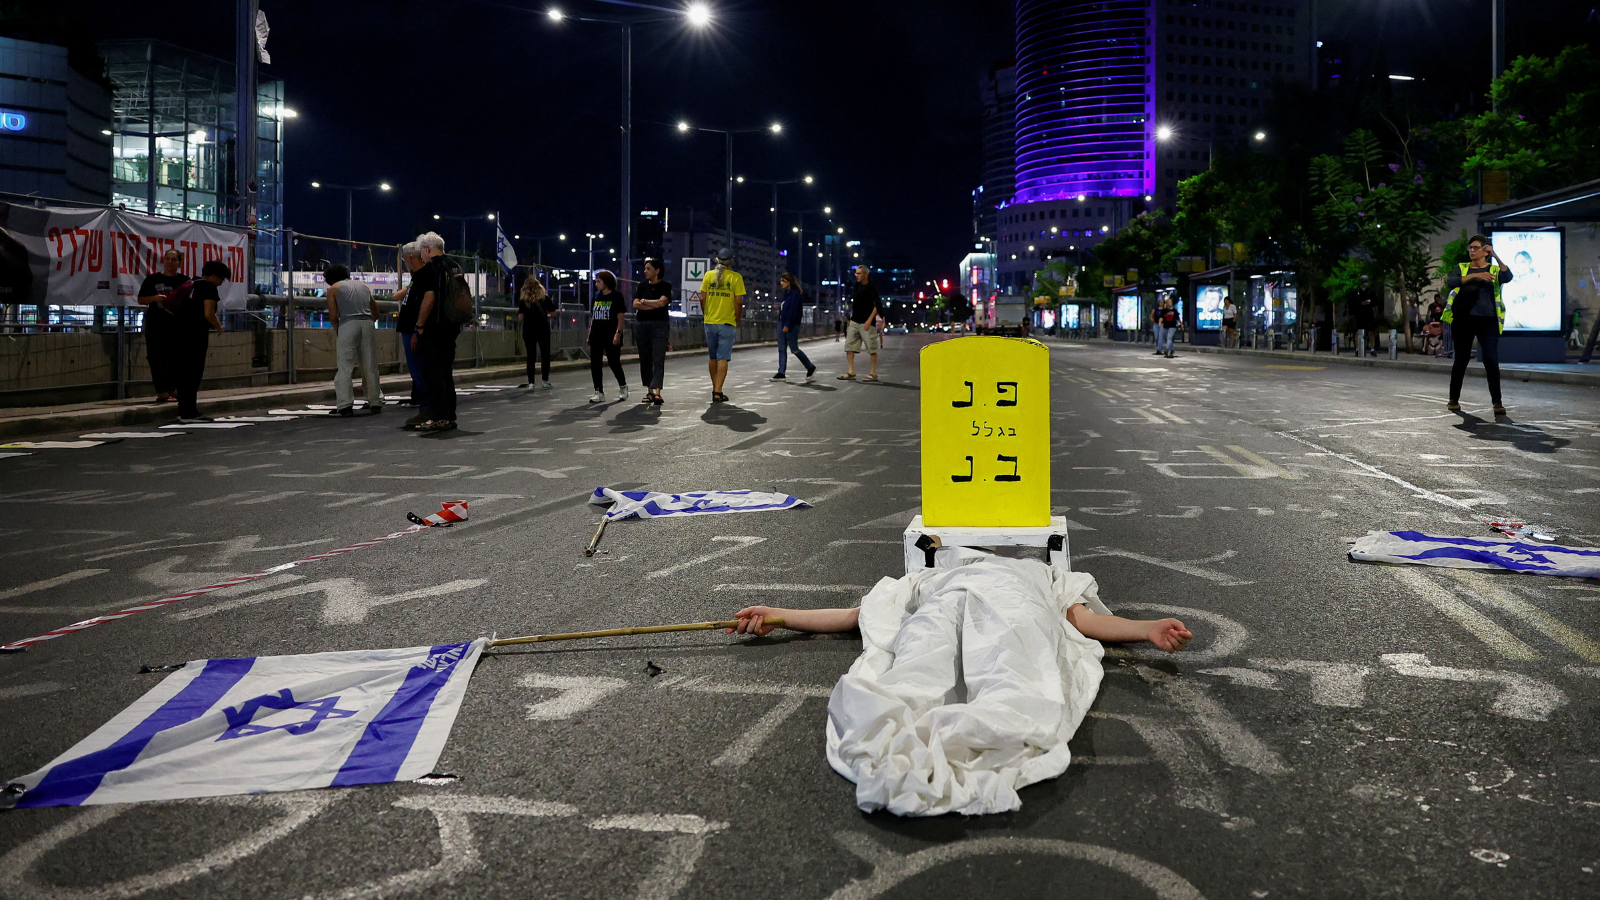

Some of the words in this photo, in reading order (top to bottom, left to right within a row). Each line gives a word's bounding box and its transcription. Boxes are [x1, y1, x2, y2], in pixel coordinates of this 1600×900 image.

[48, 226, 104, 277] שלך?
[110, 231, 141, 279] הבן
[180, 240, 198, 278] זה
[227, 245, 244, 283] מה
[972, 420, 1017, 437] בגלל
